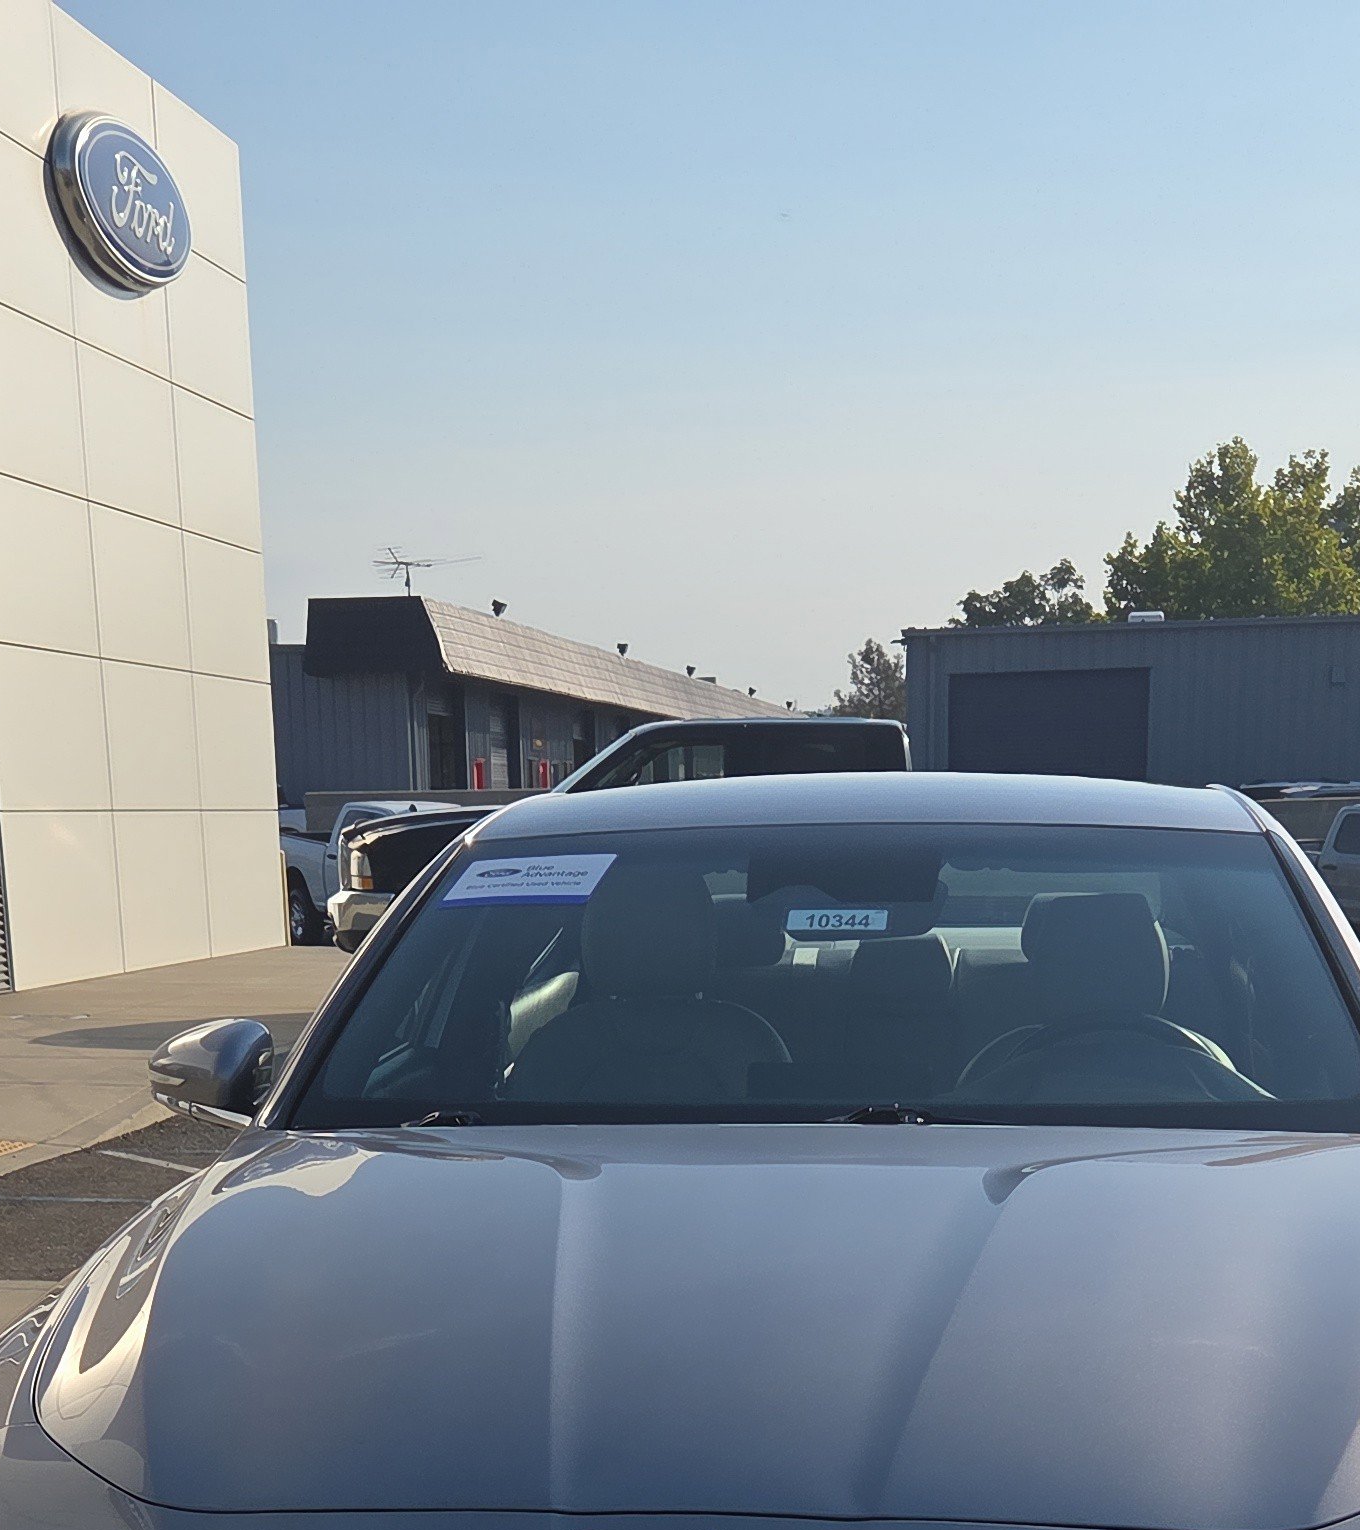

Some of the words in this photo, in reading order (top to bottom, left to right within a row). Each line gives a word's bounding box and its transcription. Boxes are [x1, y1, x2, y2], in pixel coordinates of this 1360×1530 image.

[111, 150, 176, 255] Ford
[520, 869, 589, 879] Advantage
[806, 913, 871, 928] 10344
